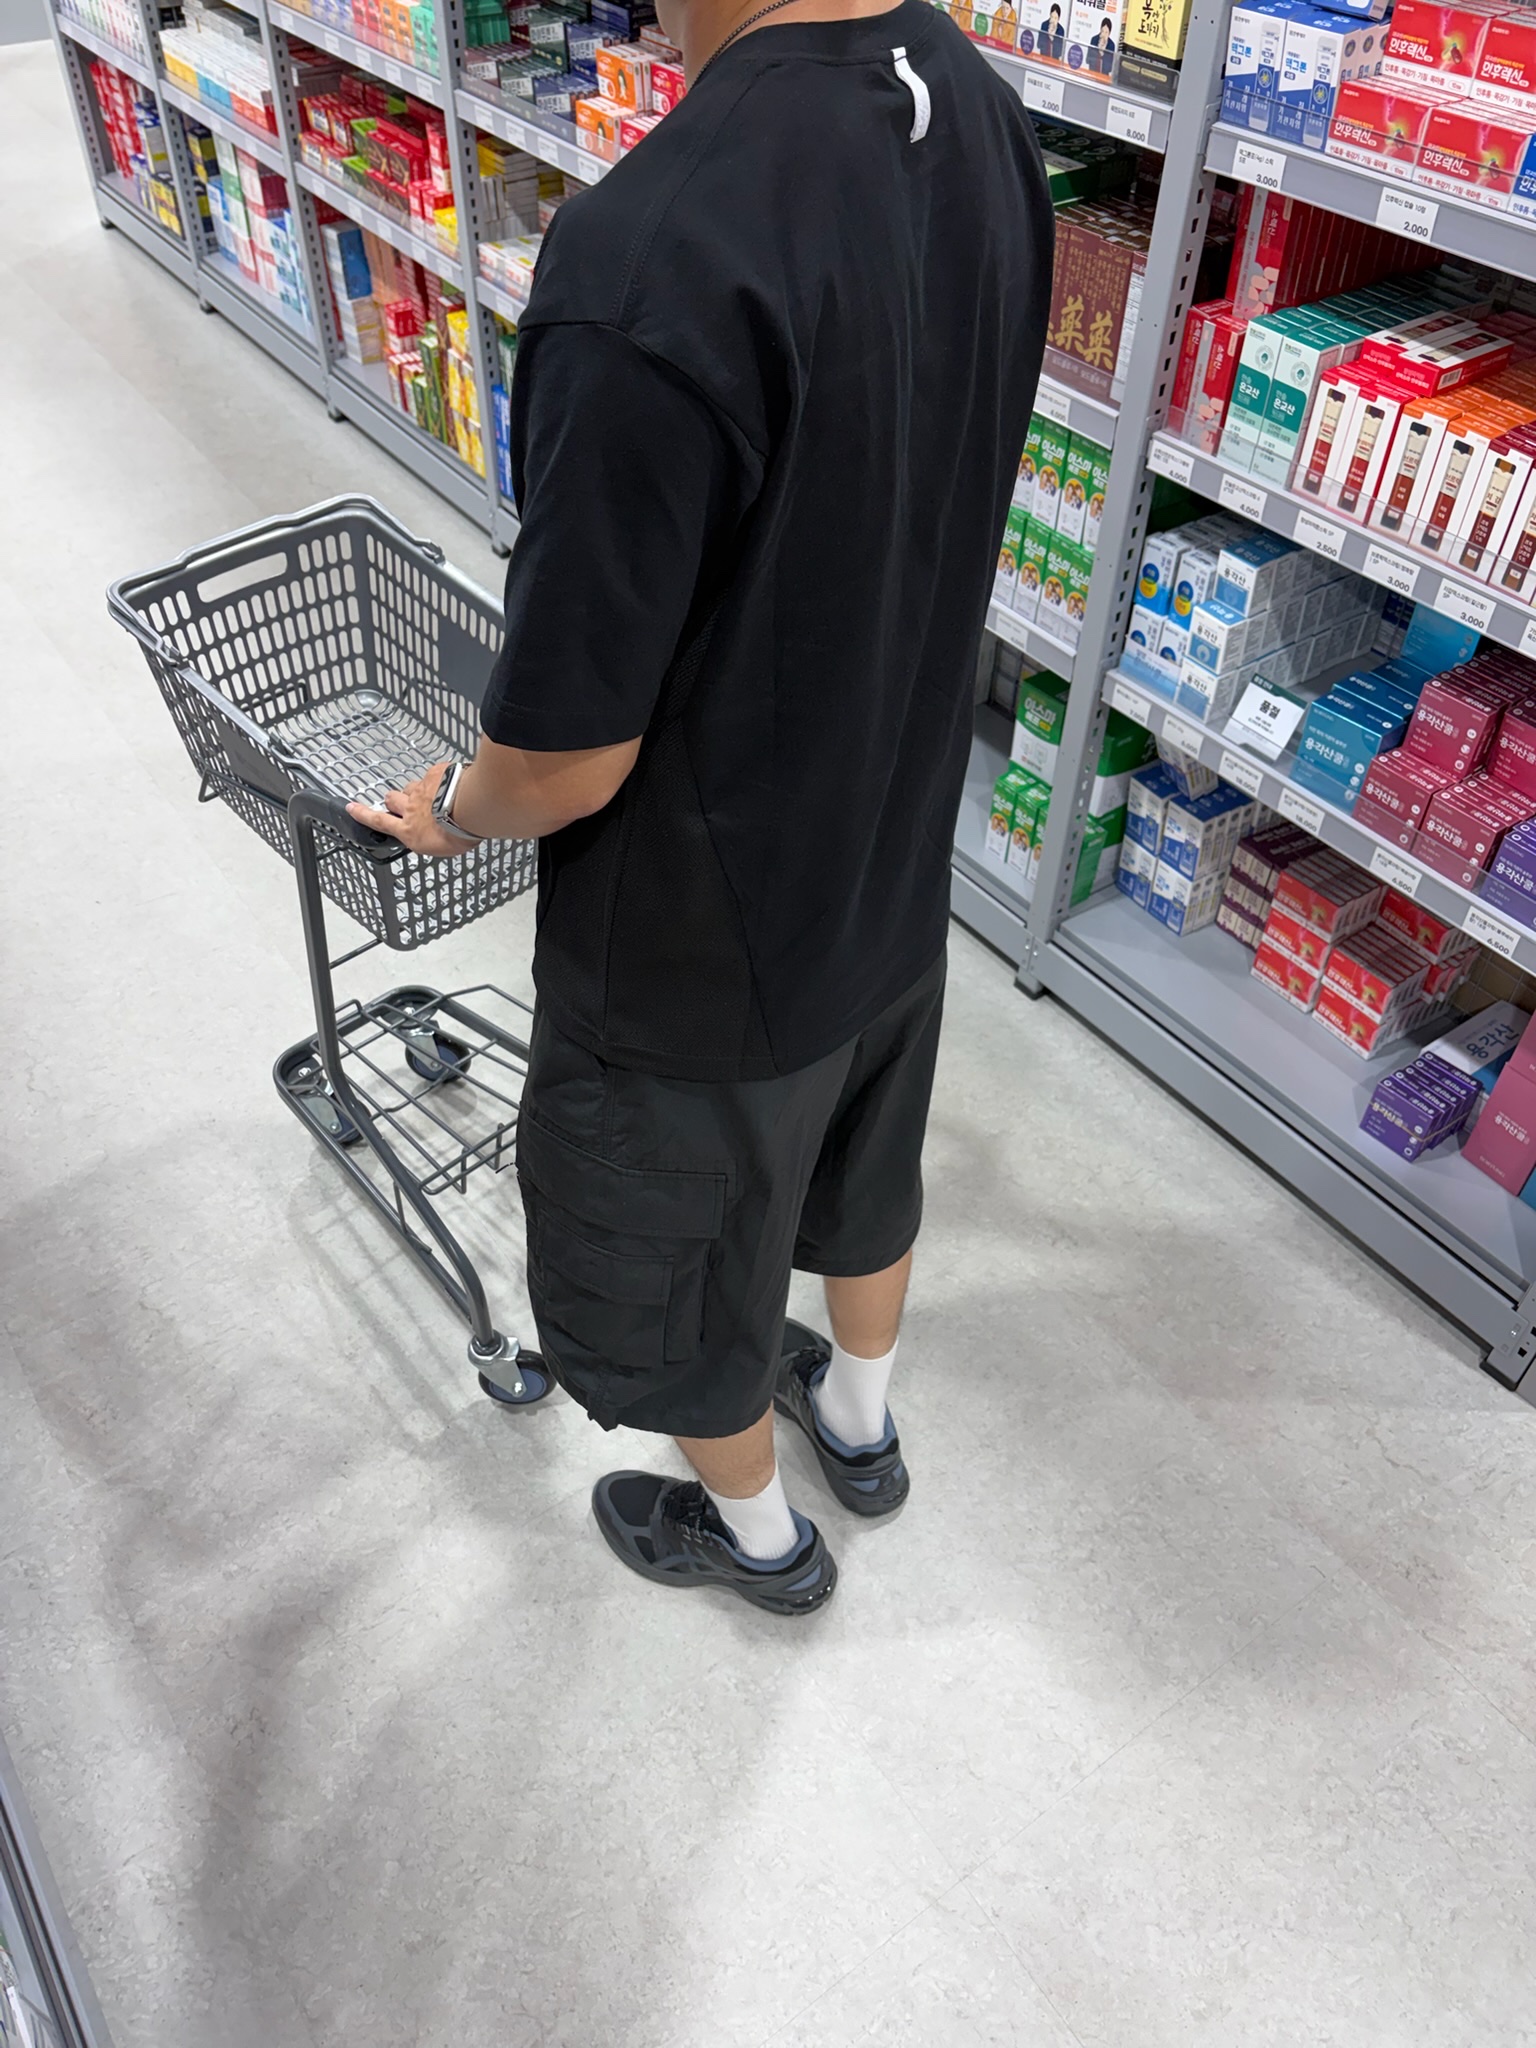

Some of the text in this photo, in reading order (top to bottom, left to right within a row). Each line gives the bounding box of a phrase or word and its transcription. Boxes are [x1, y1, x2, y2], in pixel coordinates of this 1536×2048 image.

[1256, 173, 1278, 189] 3,000
[1403, 221, 1428, 237] 2,000
[1316, 541, 1338, 557] 2,500
[1224, 565, 1247, 586] 용각산
[1386, 575, 1410, 593] 3,000
[1459, 611, 1485, 629] 3,000
[1197, 624, 1218, 644] 용각산
[1259, 700, 1281, 720] 품절
[1417, 710, 1454, 736] 용각산쿨
[1487, 937, 1510, 954] 6,500
[1466, 1023, 1520, 1060] 용각산
